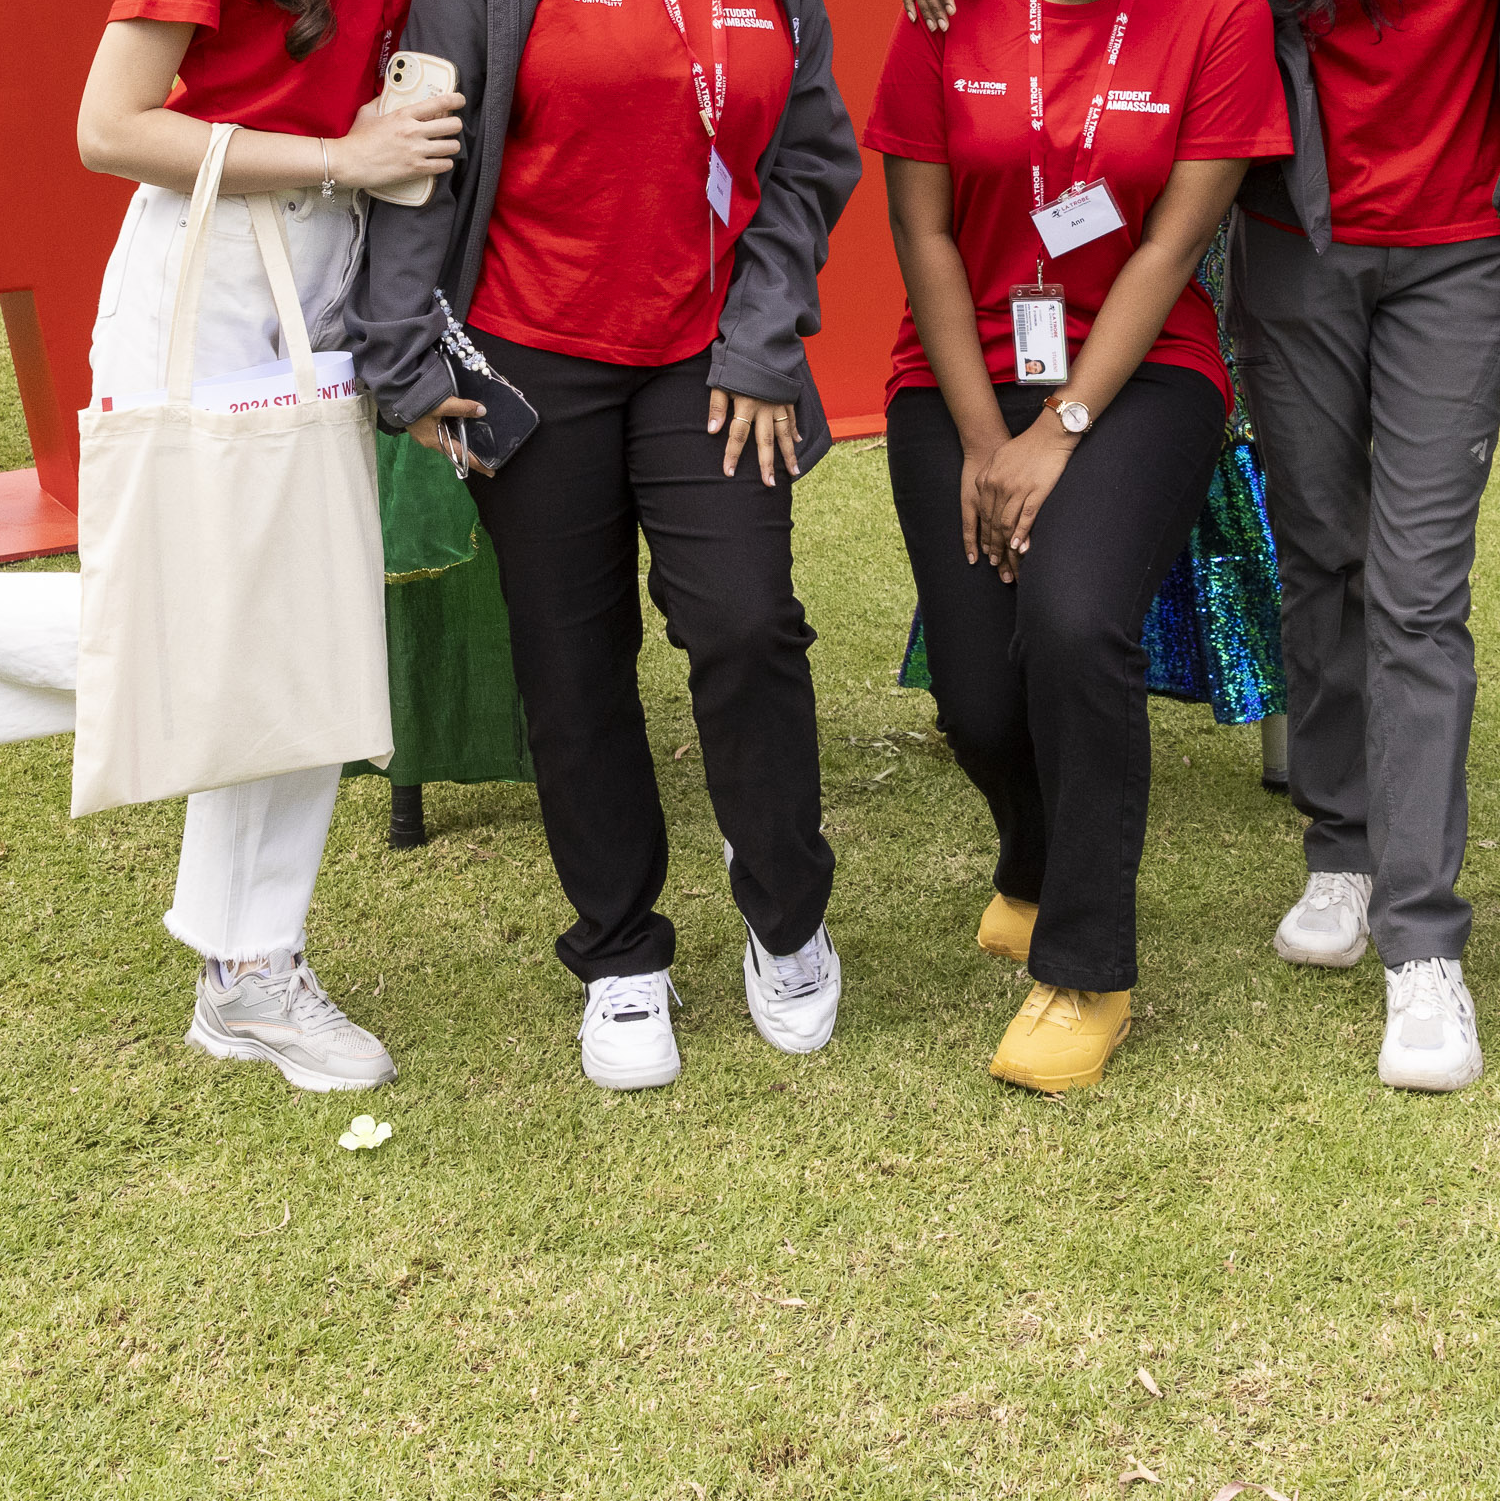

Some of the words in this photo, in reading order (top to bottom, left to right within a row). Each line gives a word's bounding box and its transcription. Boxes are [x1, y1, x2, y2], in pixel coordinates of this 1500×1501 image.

[672, 3, 686, 34] TROBE
[723, 7, 757, 18] STUDENT
[1029, 19, 1038, 31] LA
[1115, 25, 1127, 38] LA
[1107, 37, 1123, 66] TROBE
[698, 75, 708, 89] LA
[714, 62, 723, 94] TROBE
[967, 79, 980, 89] LA
[979, 81, 1008, 91] TROBE
[967, 87, 1007, 96] UNIVERSITY
[1029, 76, 1038, 105] TROBE
[1107, 89, 1152, 102] STUDENT
[701, 87, 714, 119] TROBE
[715, 92, 723, 107] LA
[1030, 104, 1039, 118] LA
[1091, 107, 1102, 120] LA
[1105, 100, 1171, 114] AMBASSADOR
[1083, 120, 1098, 150] TROBE
[1032, 165, 1040, 195] TROBE
[1034, 194, 1041, 208] LA
[1070, 217, 1085, 228] Ann
[273, 383, 339, 407] STNT
